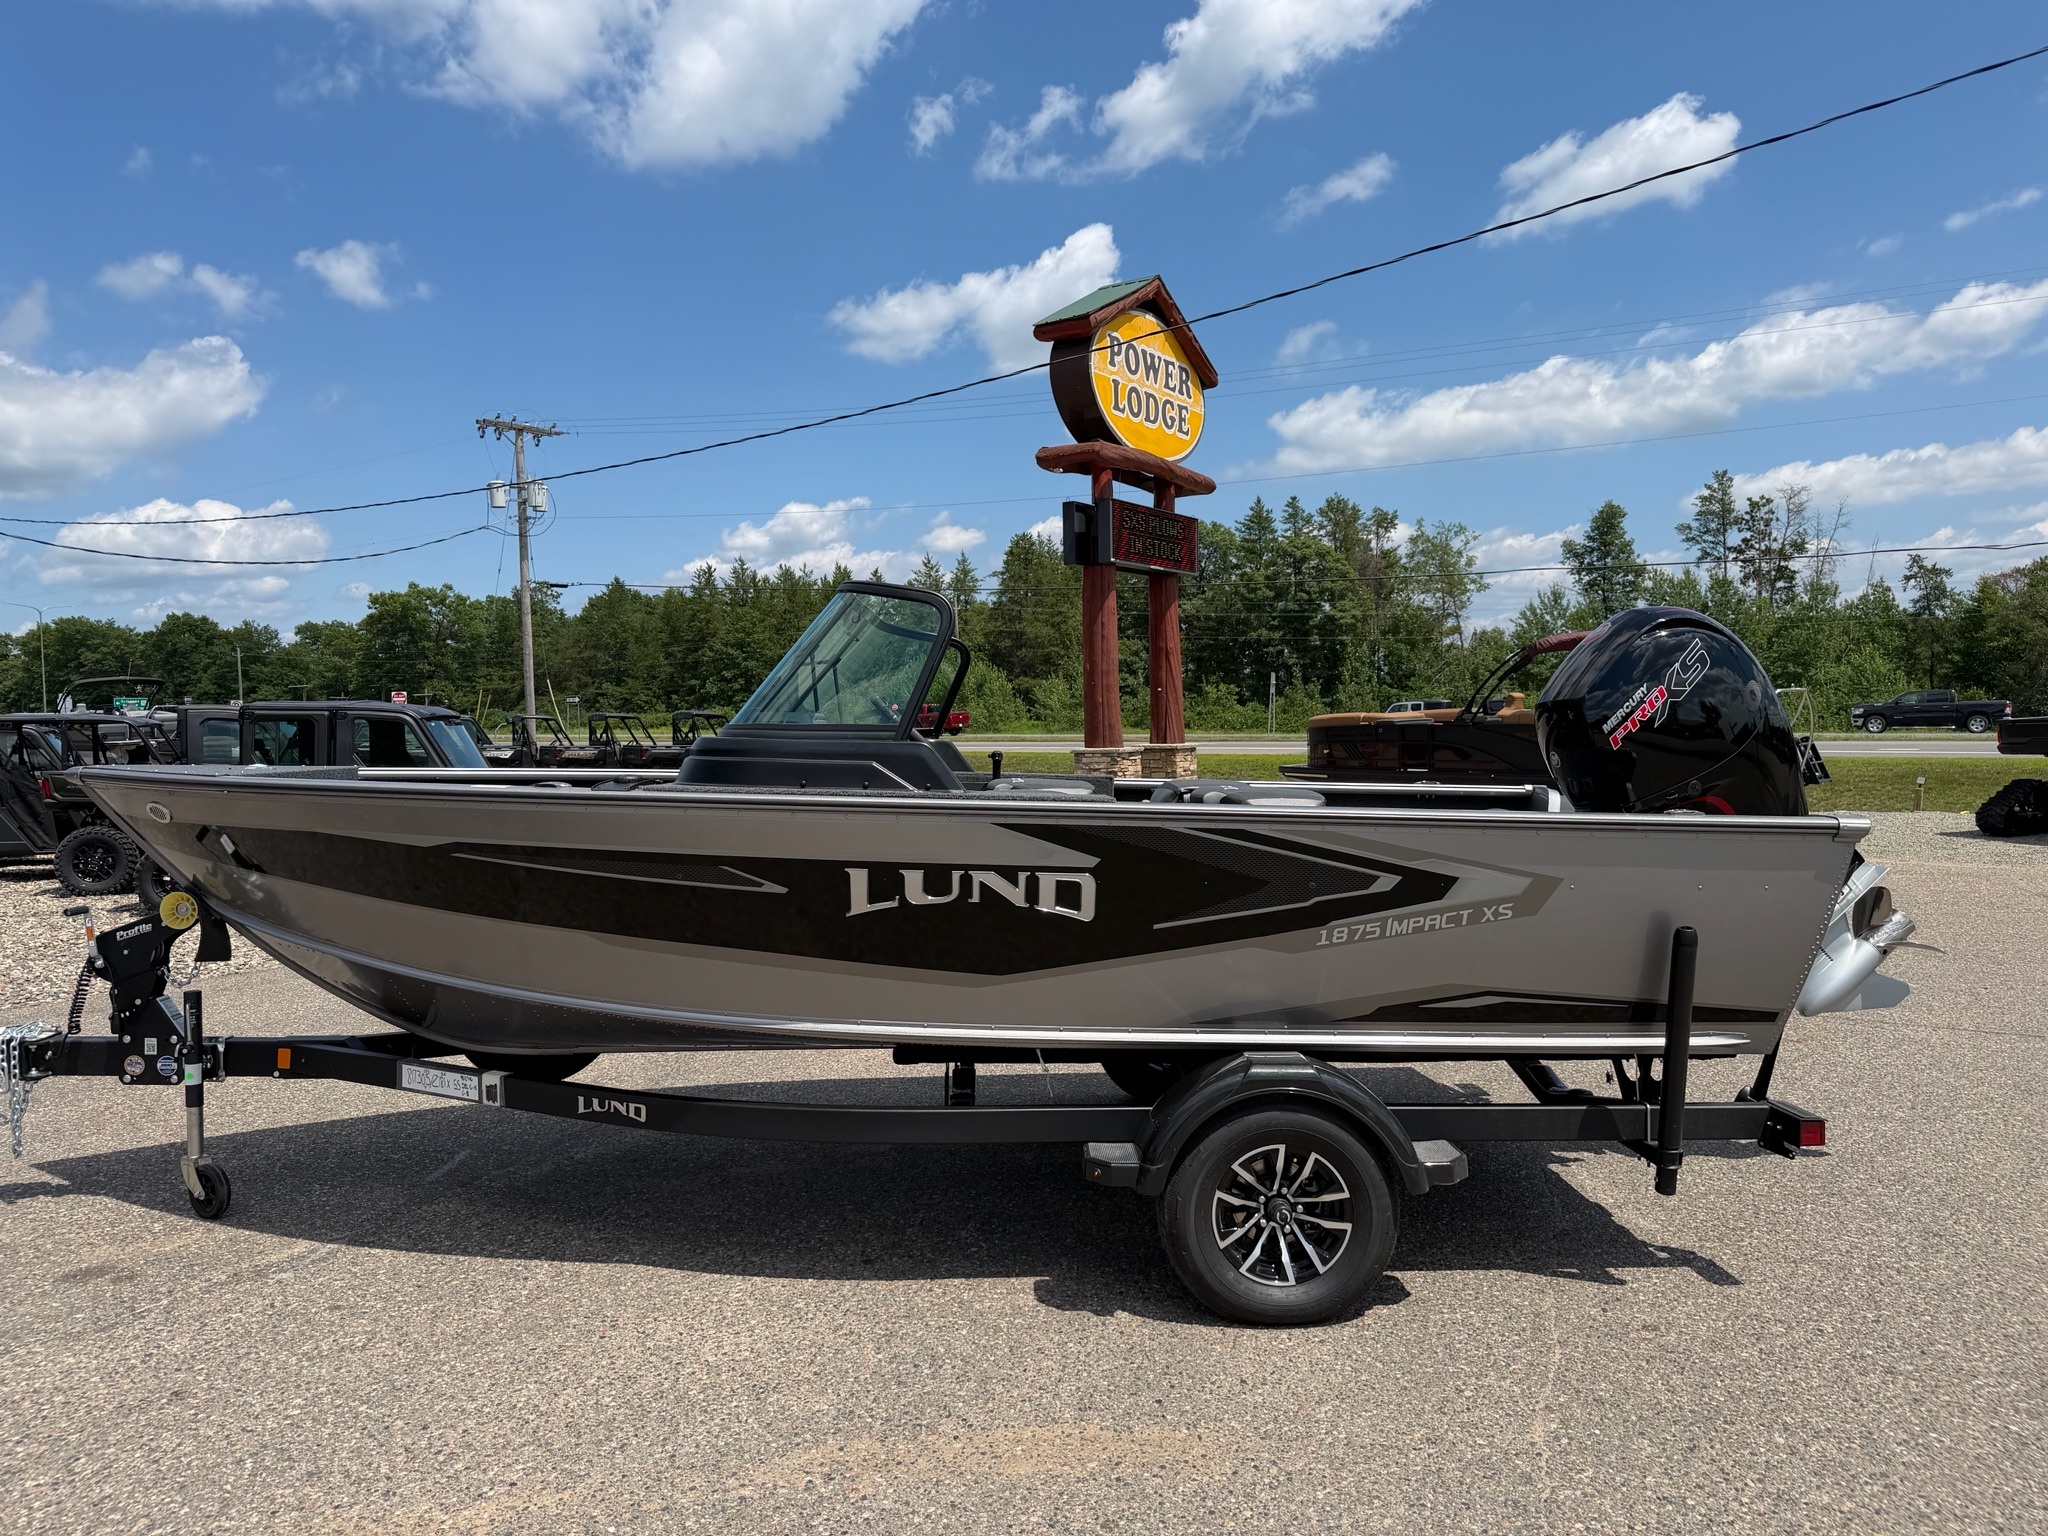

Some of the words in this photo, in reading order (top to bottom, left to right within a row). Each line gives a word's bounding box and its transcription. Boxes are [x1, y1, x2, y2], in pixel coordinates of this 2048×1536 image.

[1107, 332, 1193, 400] POWER
[1111, 378, 1190, 437] LODGE
[1602, 682, 1649, 735] MERCURY
[844, 867, 1097, 922] LUND
[116, 923, 153, 941] Profile
[1315, 921, 1382, 946] 1875
[1385, 908, 1474, 937] IMPACT
[1480, 902, 1515, 924] XS
[576, 1095, 647, 1124] LUND
